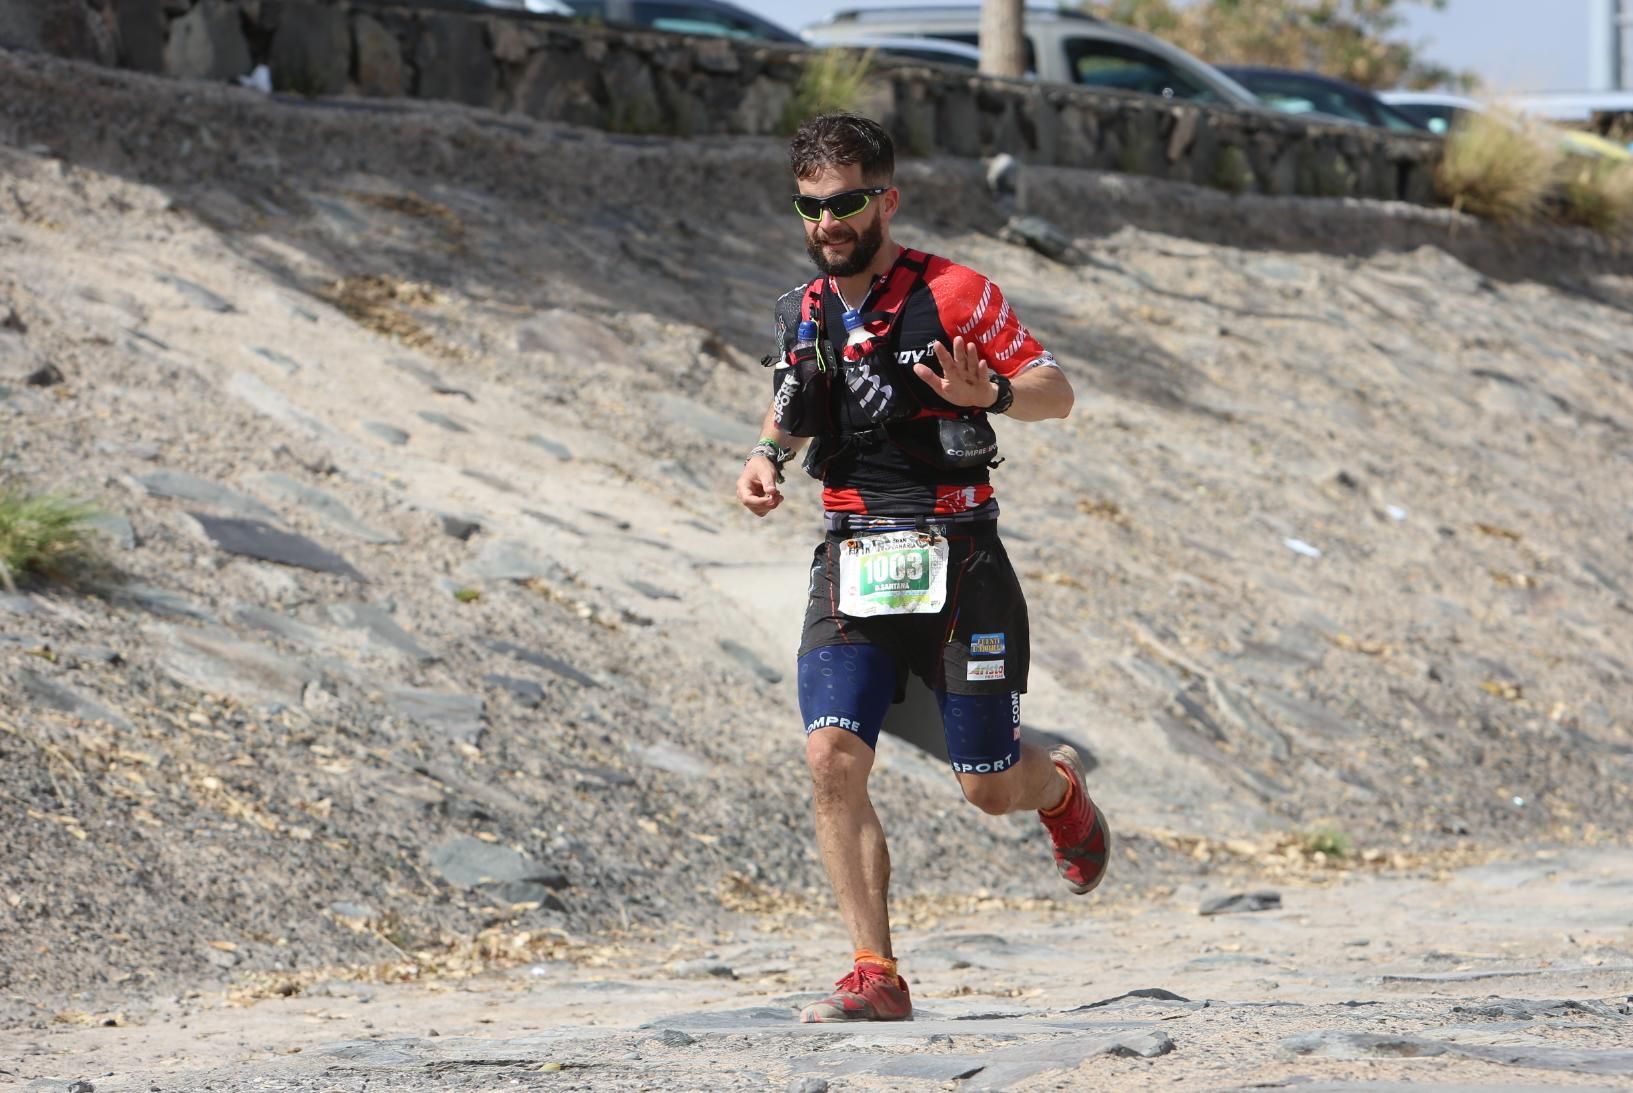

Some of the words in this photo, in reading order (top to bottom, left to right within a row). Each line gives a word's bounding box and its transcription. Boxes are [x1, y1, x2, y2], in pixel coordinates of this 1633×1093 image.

[864, 552, 923, 585] 1003
[806, 716, 861, 734] OMPRE
[953, 753, 1012, 773] SPORT
